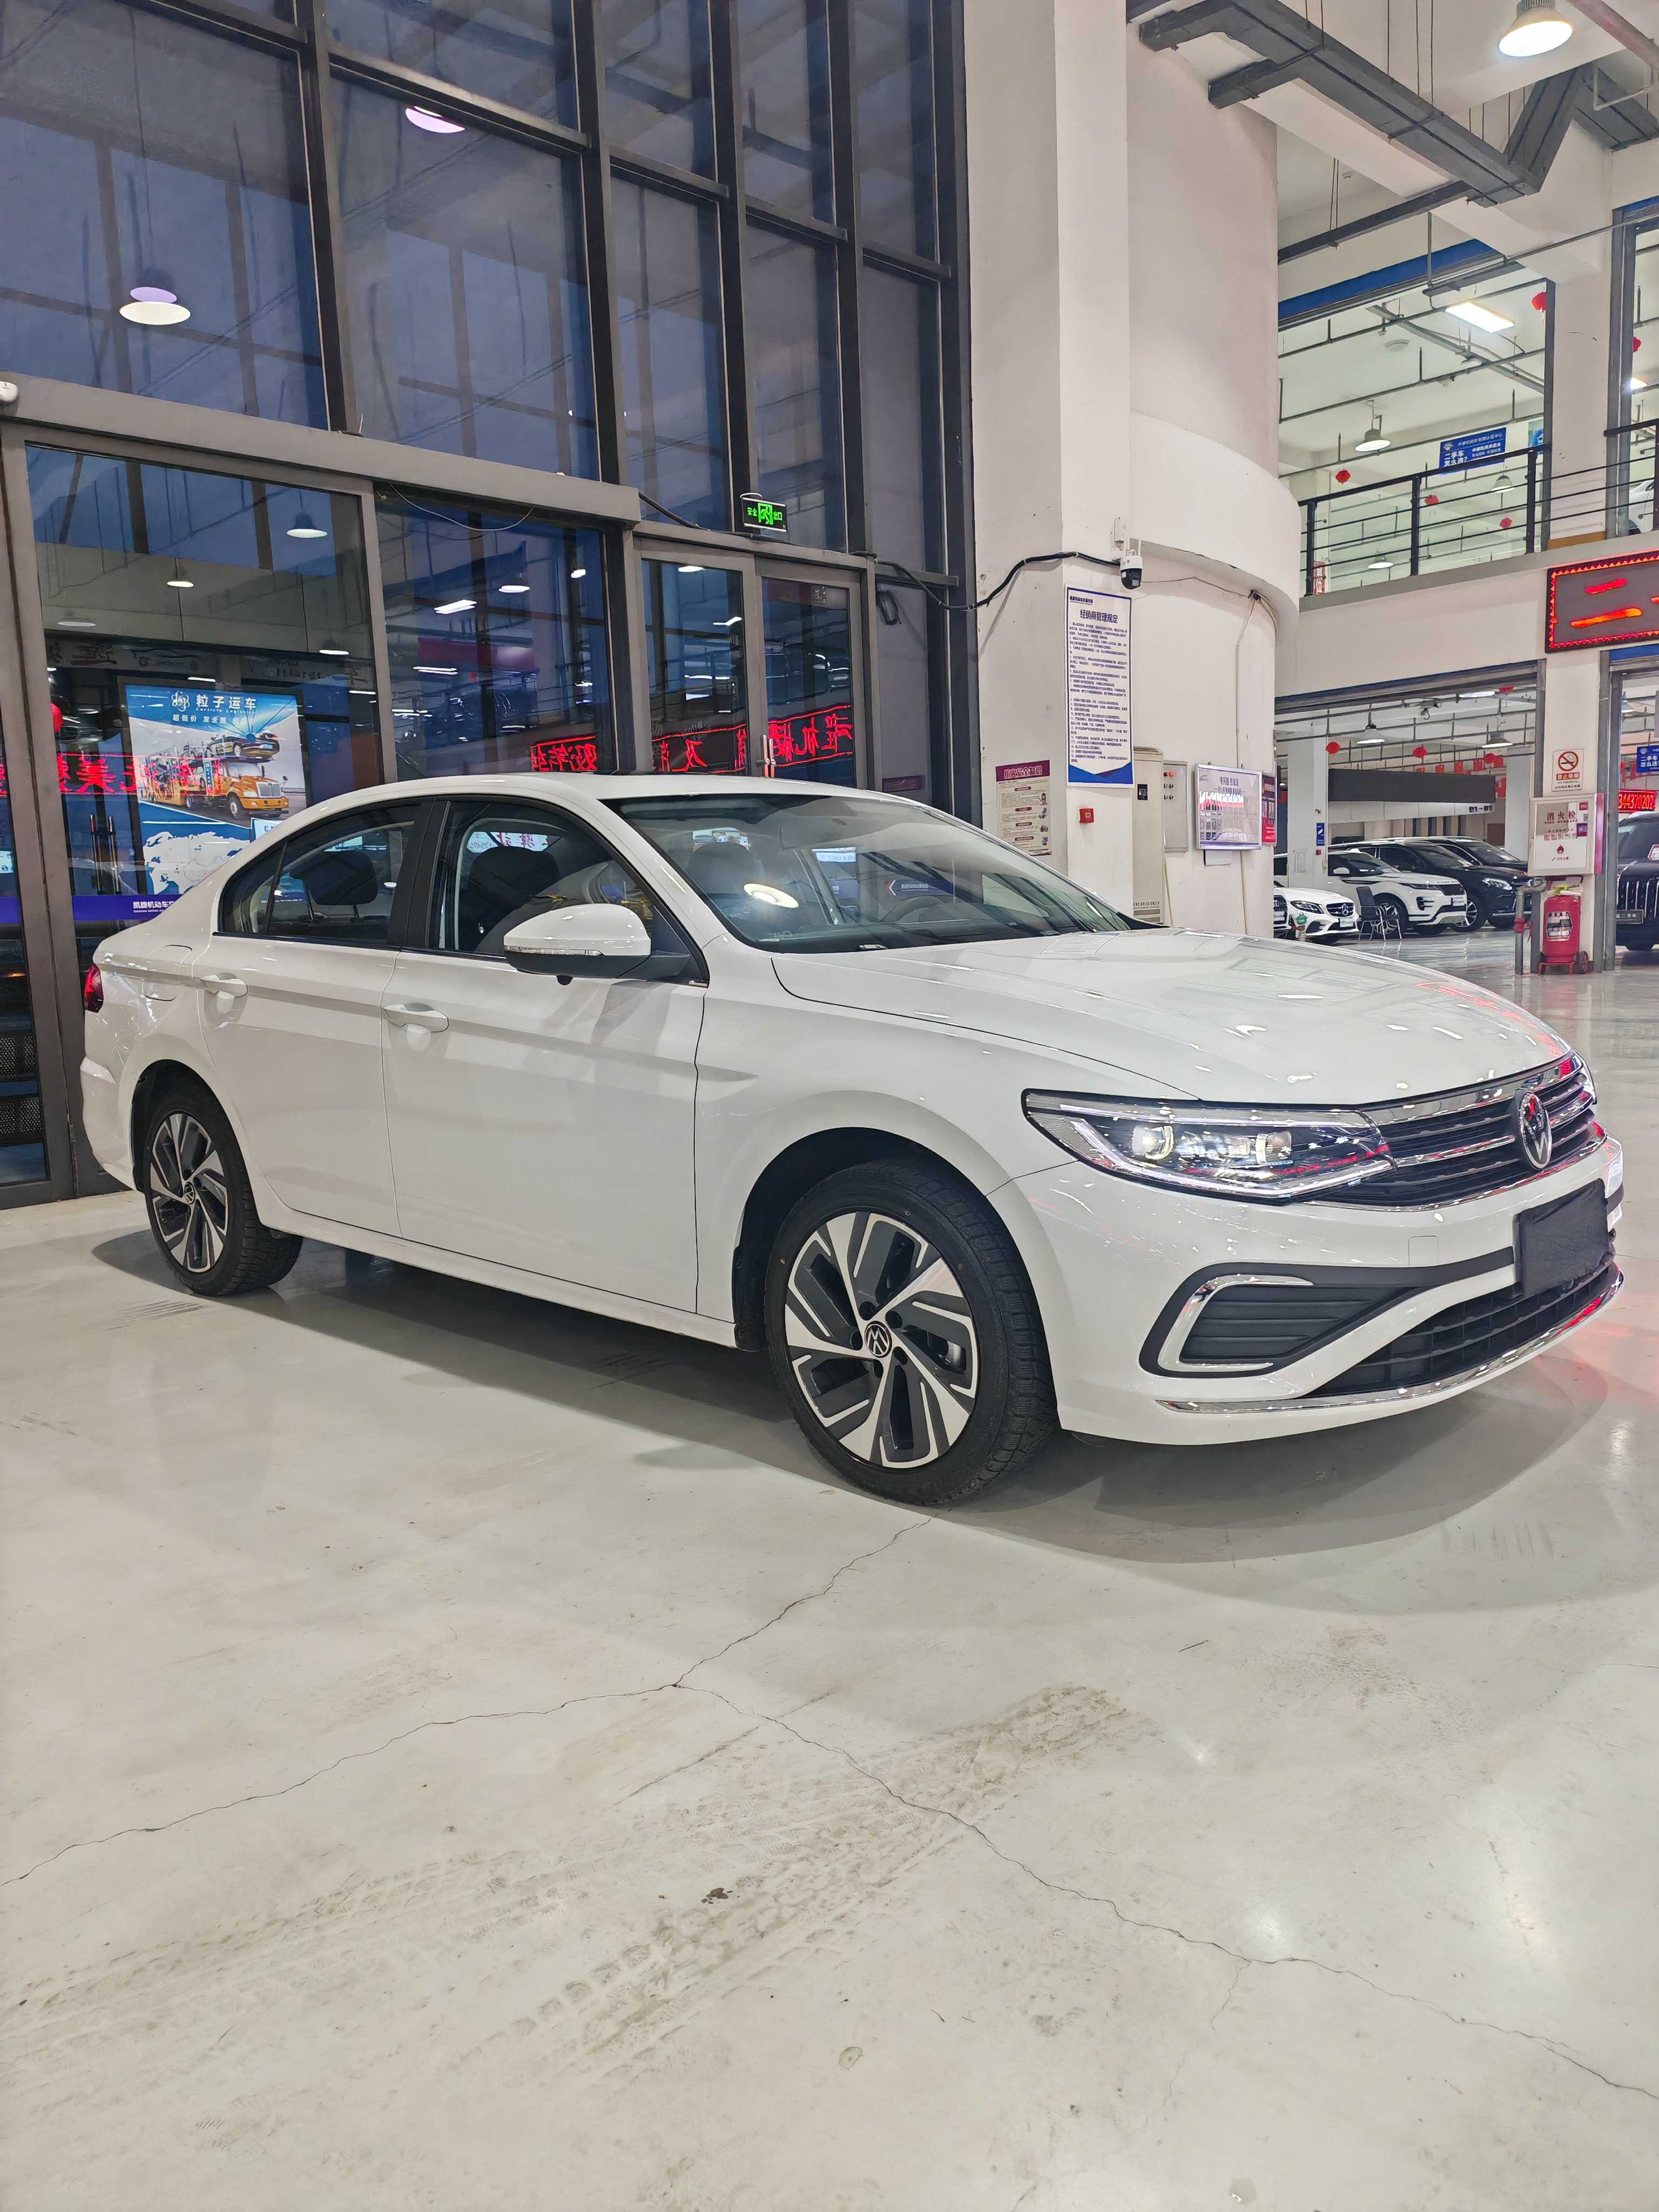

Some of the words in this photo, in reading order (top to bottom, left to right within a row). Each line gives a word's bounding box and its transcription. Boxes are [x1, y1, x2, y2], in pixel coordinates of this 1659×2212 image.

[747, 507, 757, 517] 安全
[773, 511, 783, 521] 出口
[1080, 609, 1118, 624] 经销商管理规定
[196, 694, 257, 710] 粒子运车
